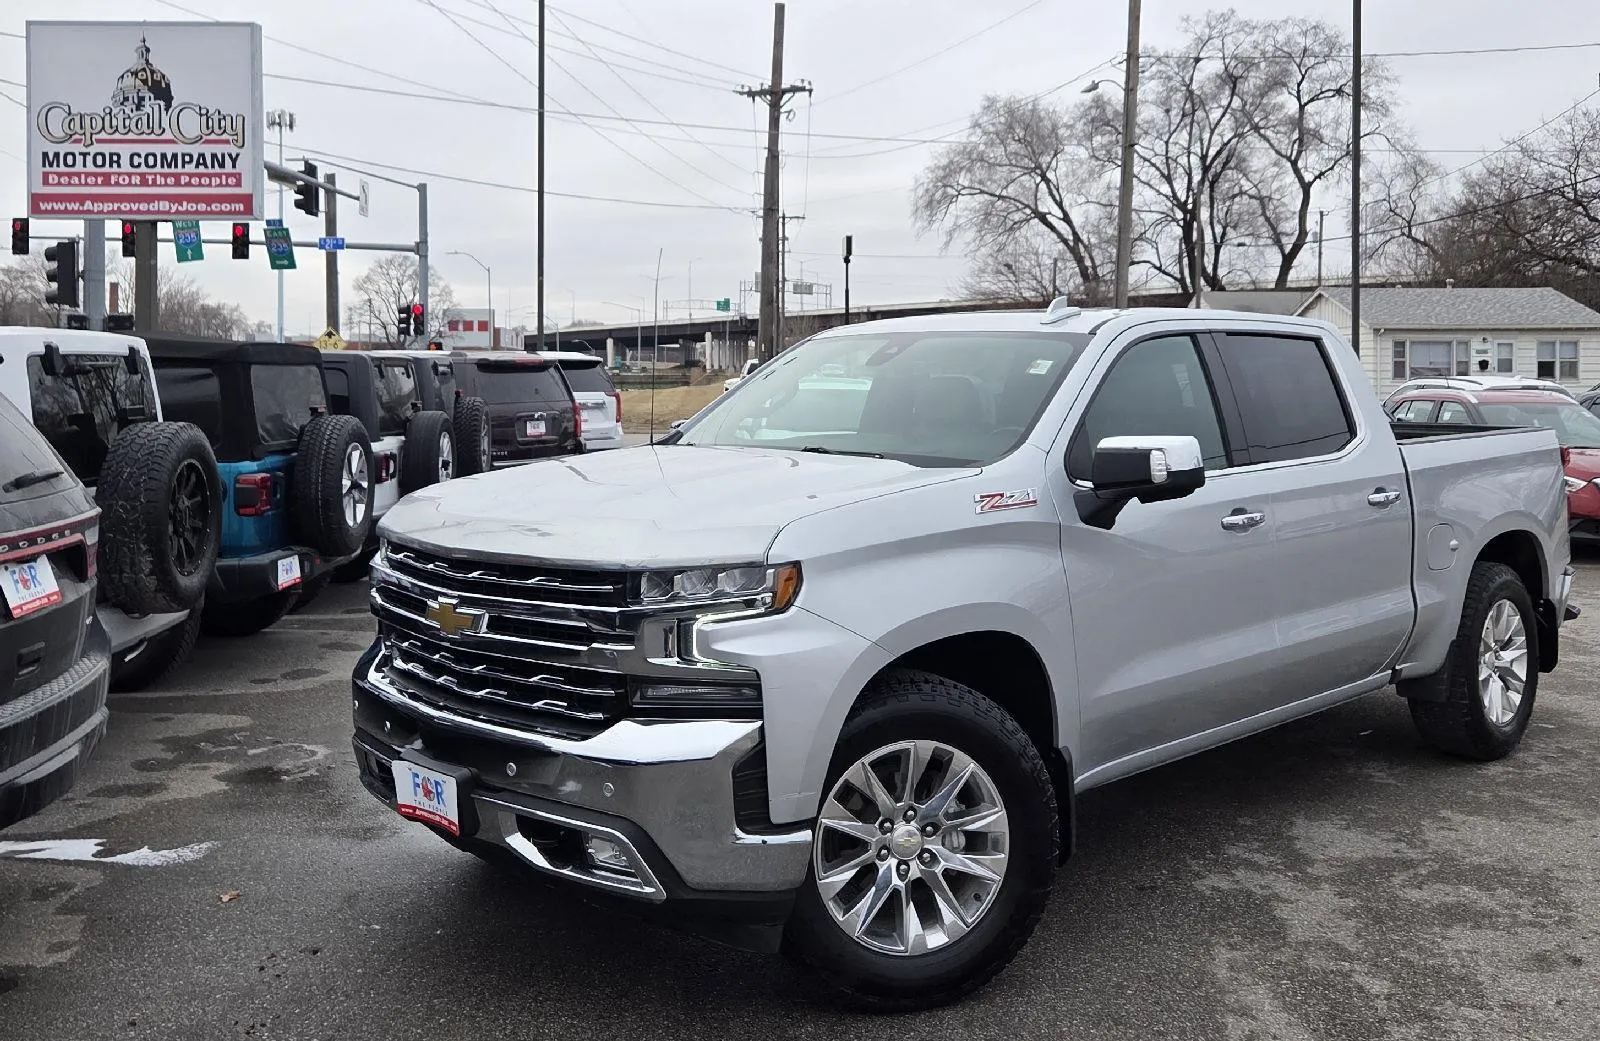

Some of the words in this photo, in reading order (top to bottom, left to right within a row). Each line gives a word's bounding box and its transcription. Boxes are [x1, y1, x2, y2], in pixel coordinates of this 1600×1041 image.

[37, 101, 165, 147] Capital
[169, 102, 245, 149] City
[42, 152, 121, 168] MOTOR
[129, 152, 240, 169] COMPANY
[48, 173, 104, 185] Dealer
[110, 175, 141, 185] FOR
[146, 174, 175, 185] The
[181, 174, 237, 187] People
[39, 200, 244, 213] www.ApprovedByJoe.com
[175, 220, 197, 228] WEST
[177, 232, 197, 244] 235
[974, 488, 1038, 514] Z71
[9, 564, 42, 594] FOR
[411, 771, 447, 809] FOR
